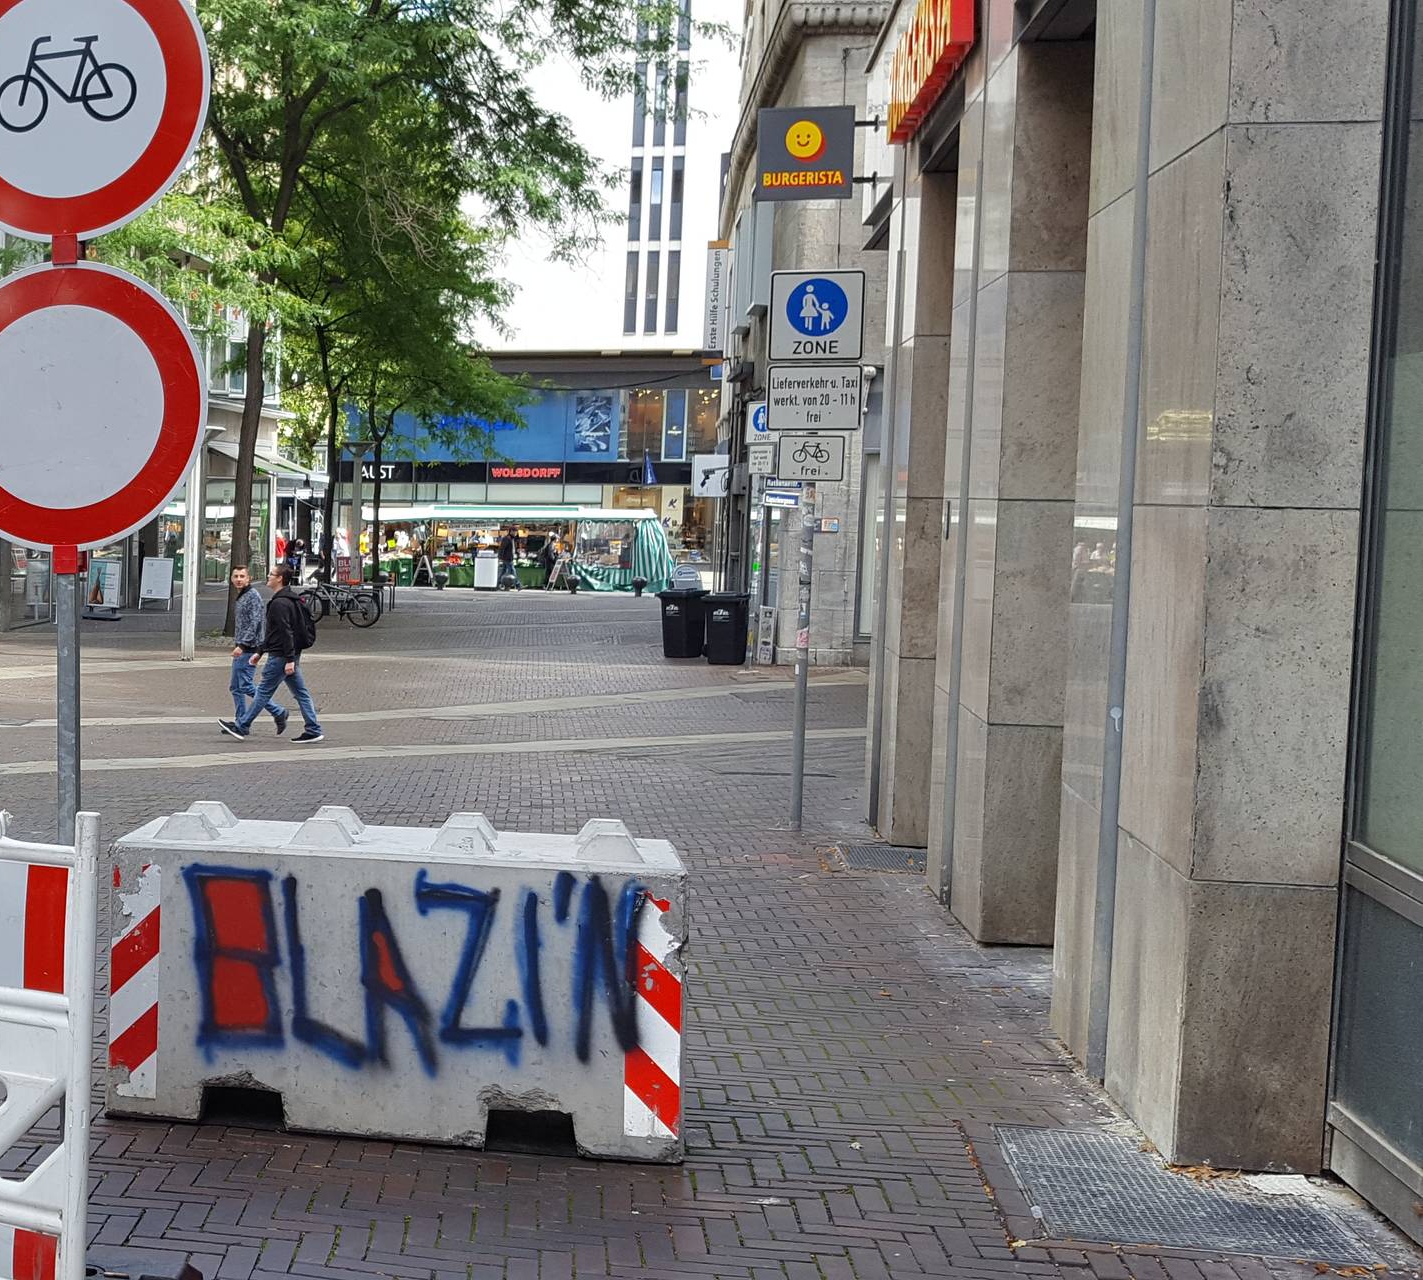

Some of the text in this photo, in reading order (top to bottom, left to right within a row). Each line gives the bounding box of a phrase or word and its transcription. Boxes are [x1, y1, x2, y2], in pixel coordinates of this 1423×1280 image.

[762, 170, 845, 188] BURGERISTA
[707, 250, 723, 350] Erste Hilfe Schulungen
[792, 341, 839, 355] ZONE
[772, 375, 829, 391] Lieferverkehr
[842, 376, 858, 390] Taxi
[773, 393, 800, 407] werkt.
[802, 393, 818, 406] von
[819, 393, 831, 406] 20
[840, 393, 849, 406] 11
[849, 393, 856, 406] h
[806, 411, 822, 424] frei
[753, 433, 772, 441] ZONE
[491, 466, 561, 479] WOLSDORFF
[800, 466, 821, 476] frei
[182, 864, 653, 1078] BLAZI'N
